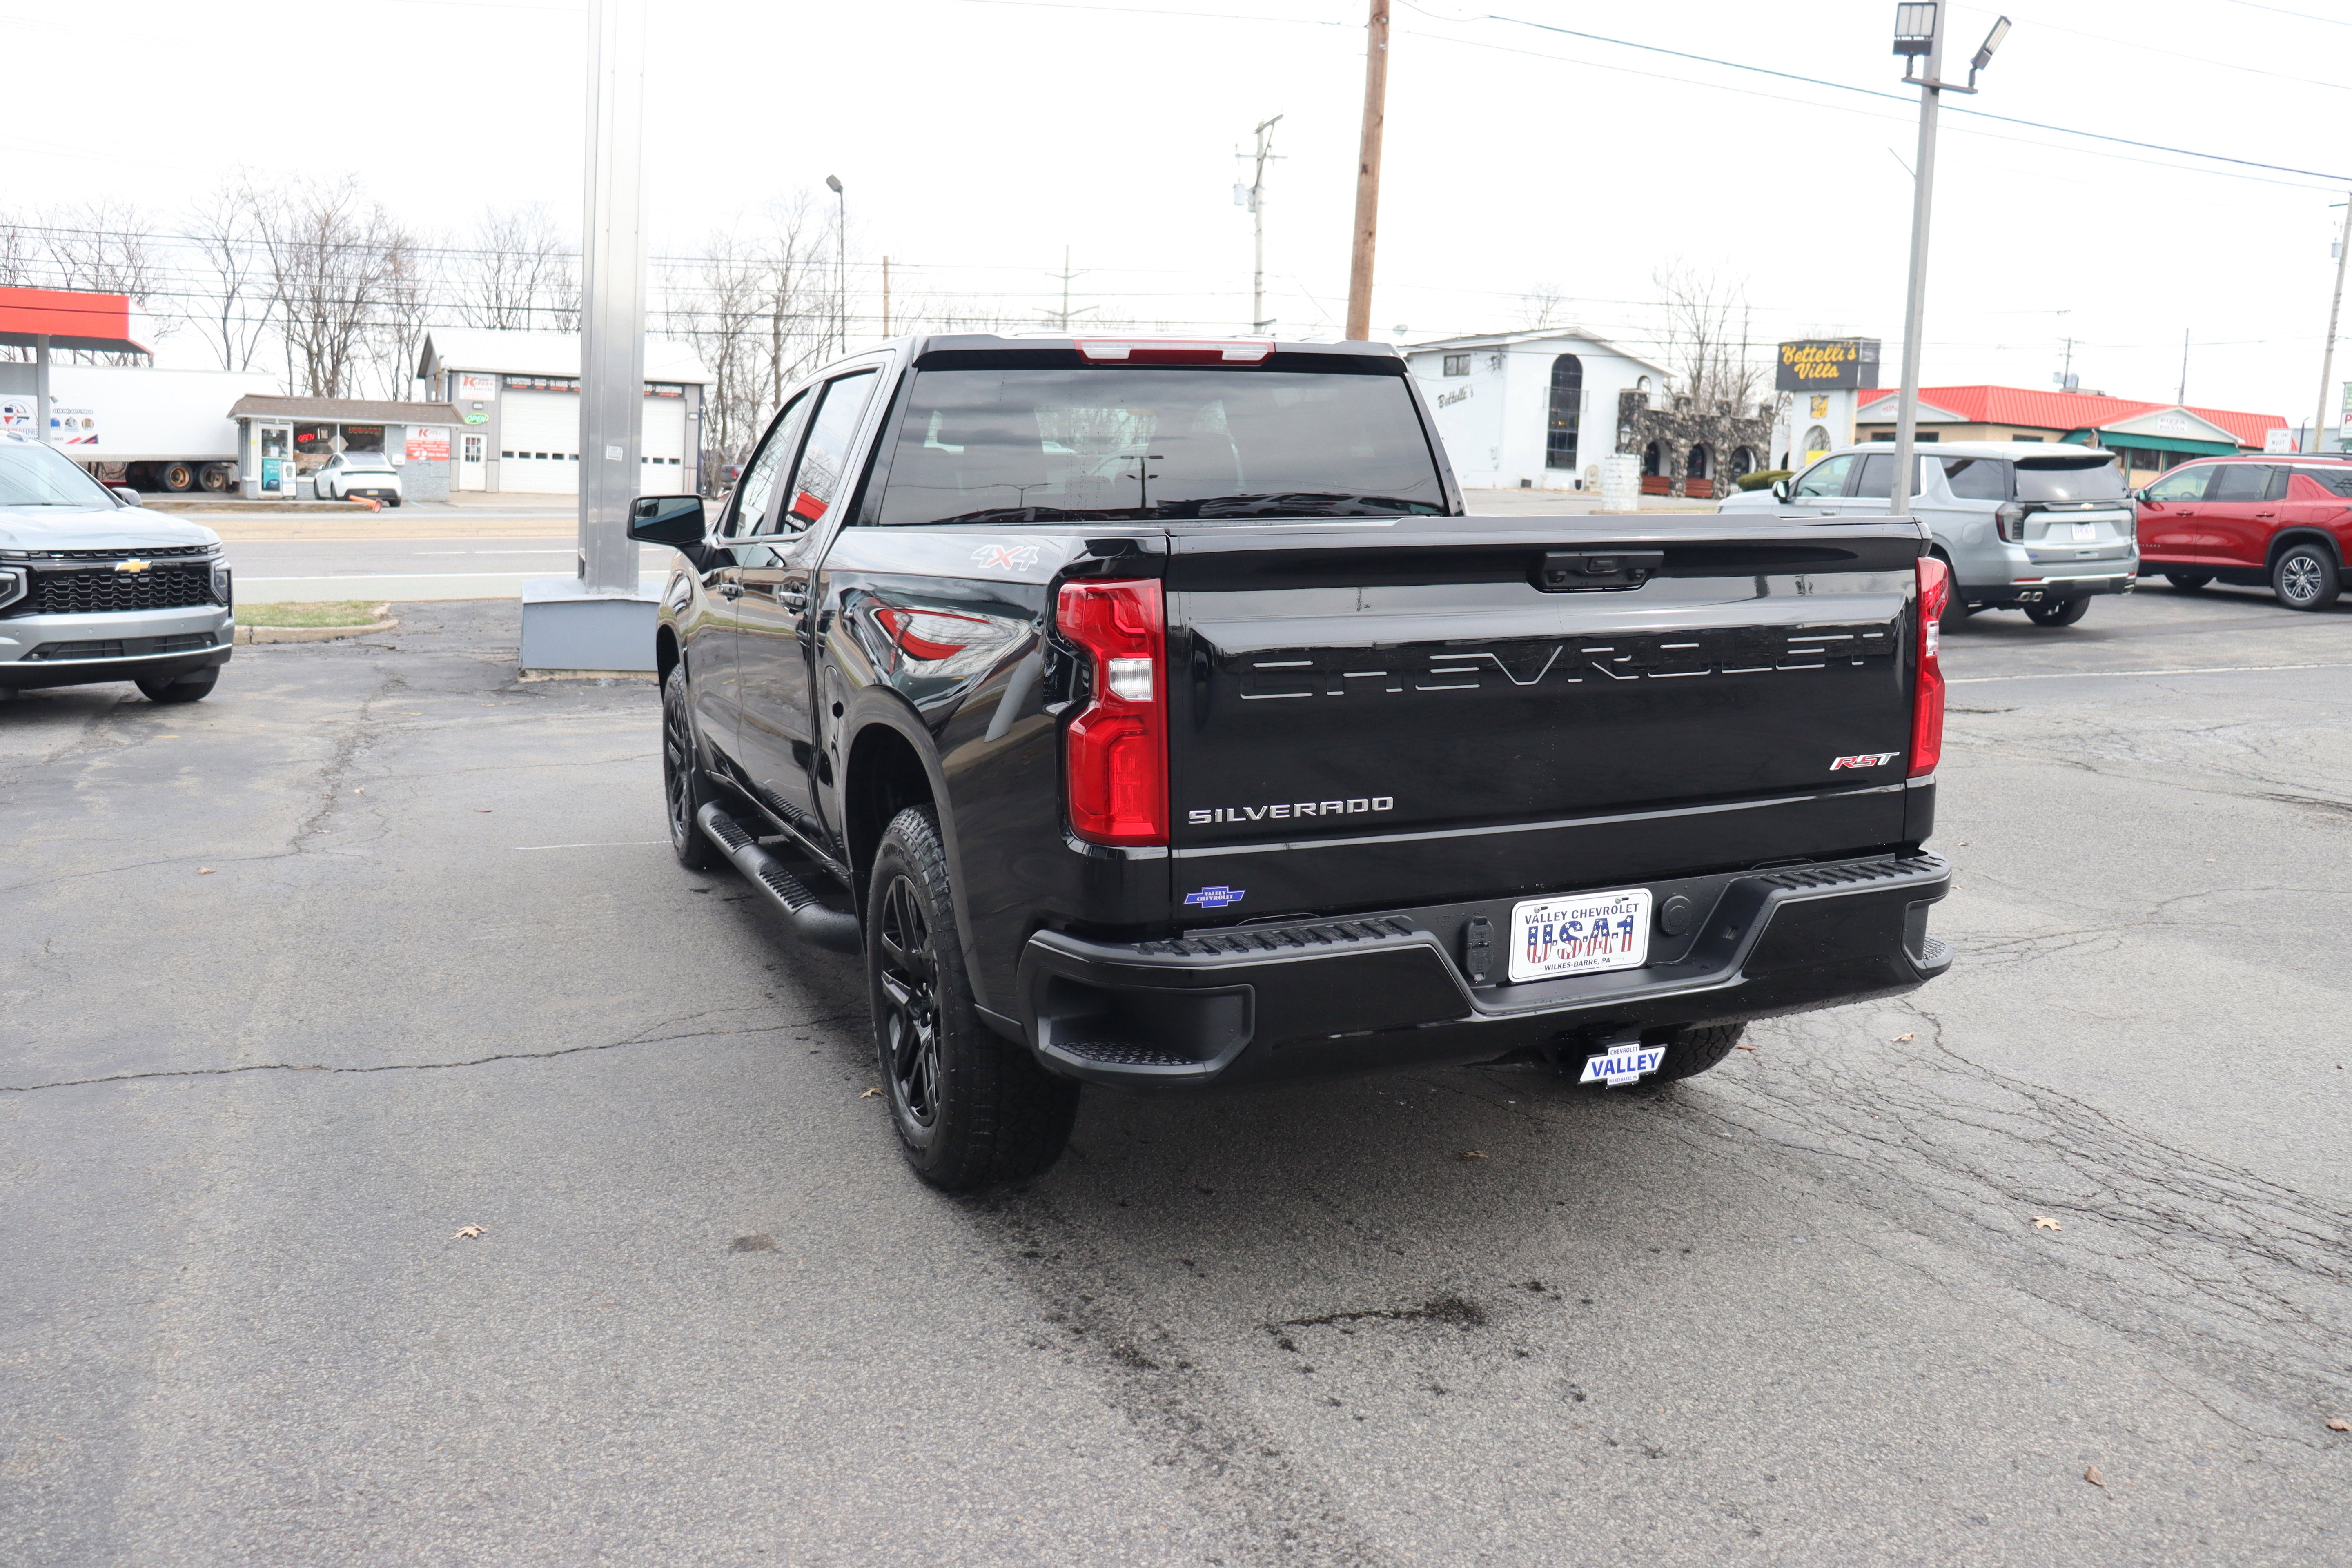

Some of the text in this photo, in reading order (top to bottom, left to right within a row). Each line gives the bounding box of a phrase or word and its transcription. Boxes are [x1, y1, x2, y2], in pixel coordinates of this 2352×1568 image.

[1782, 341, 1857, 364] Bettelli's
[1794, 363, 1840, 379] Villa
[467, 414, 487, 423] OPEN
[298, 433, 316, 442] OPEN
[1240, 632, 1885, 699] CHEVROLET
[1829, 752, 1900, 771] RST
[1188, 796, 1394, 824] SILVERADO
[1525, 903, 1639, 924] VALLEY CHEVROLET
[1544, 958, 1599, 971] WILKES-BARRE,
[1610, 1046, 1638, 1055] CHEVROLET
[1591, 1052, 1659, 1077] VALLEY
